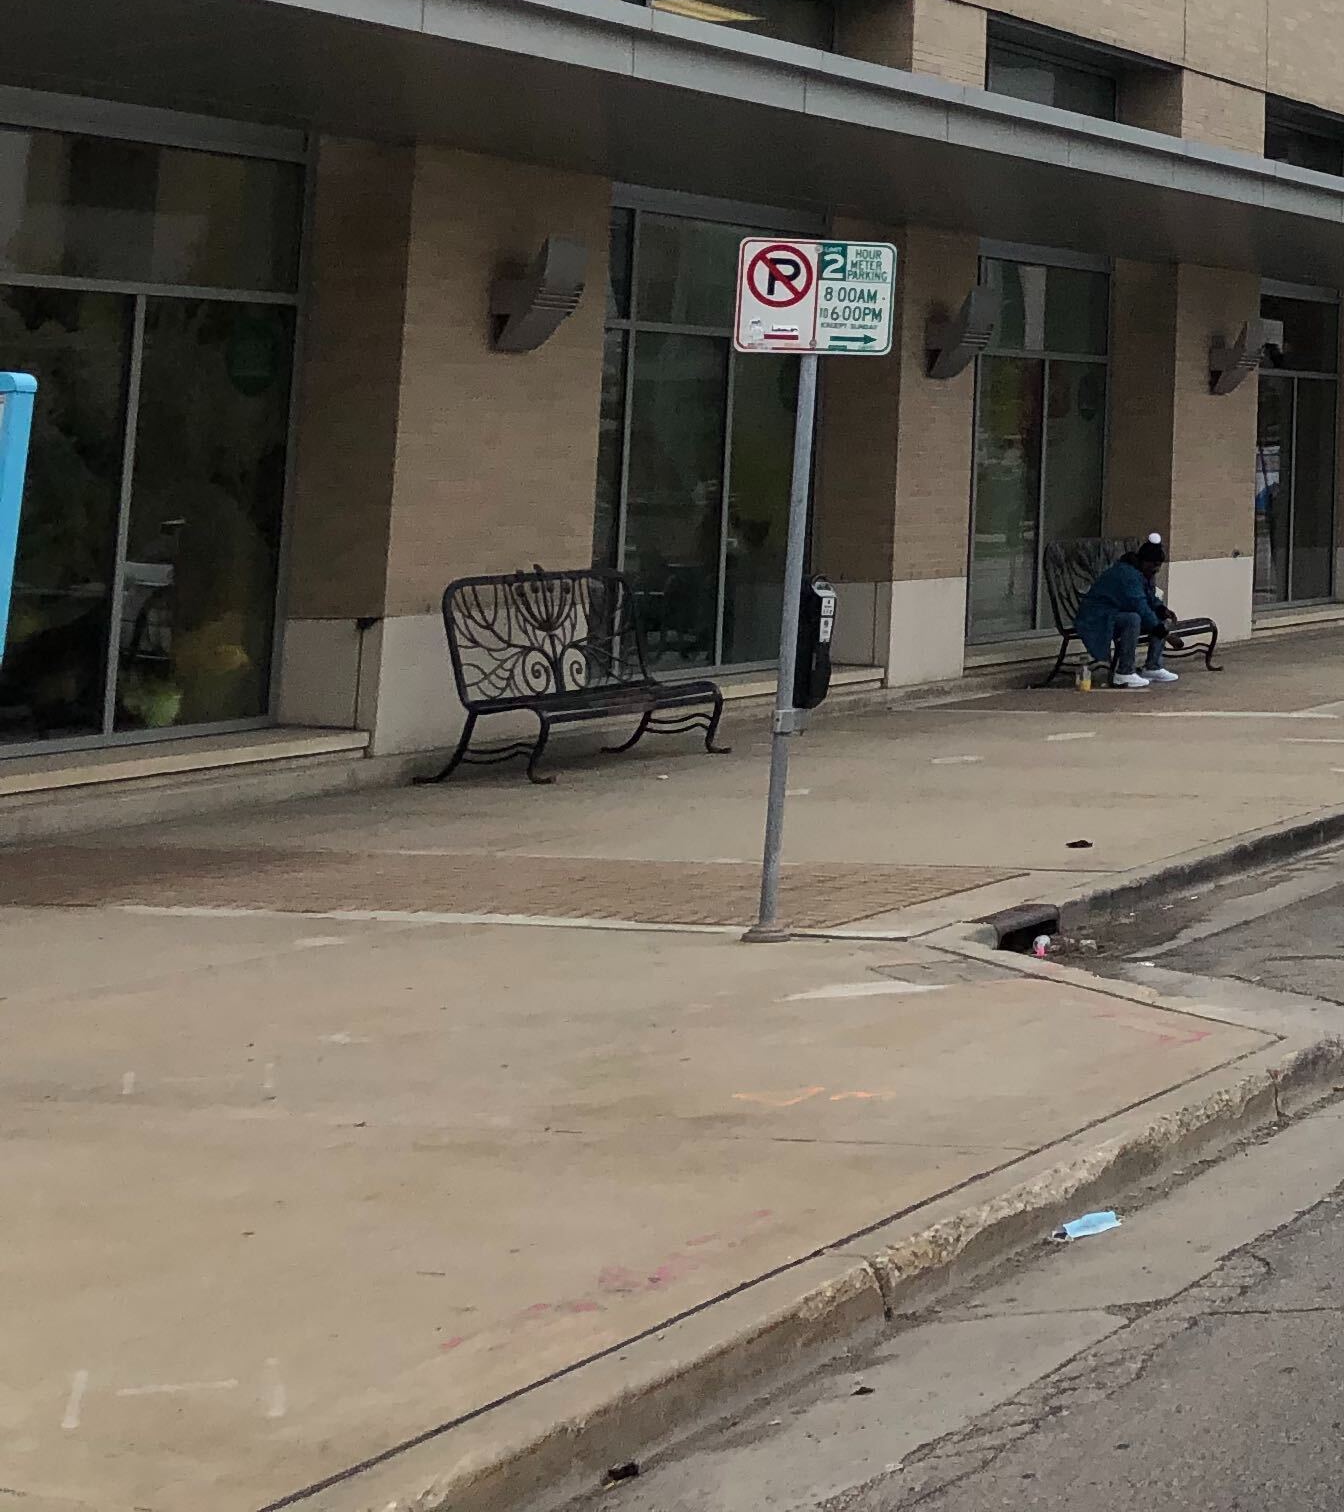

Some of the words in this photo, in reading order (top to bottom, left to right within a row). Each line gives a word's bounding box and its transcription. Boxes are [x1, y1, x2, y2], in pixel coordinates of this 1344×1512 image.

[855, 248, 883, 260] HOUR
[822, 253, 845, 279] 2
[851, 260, 883, 271] METER
[847, 269, 888, 282] PARKING
[830, 305, 883, 323] 600PM
